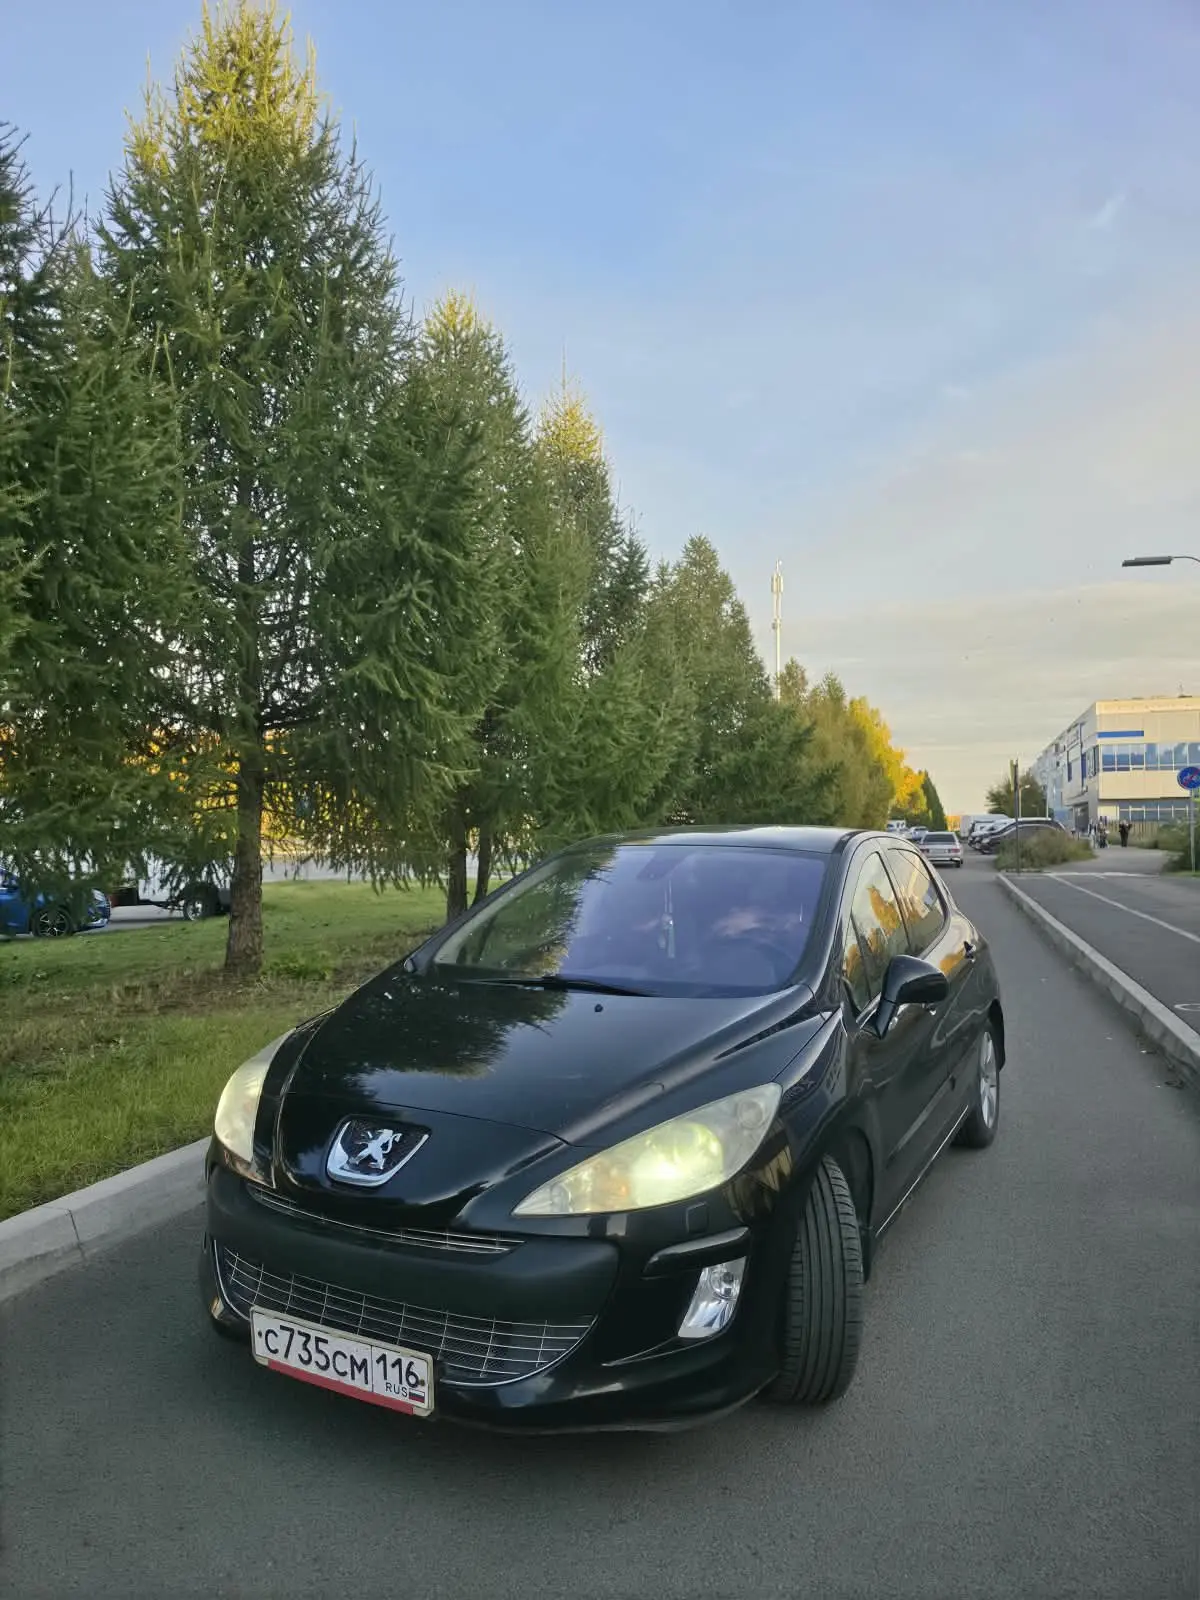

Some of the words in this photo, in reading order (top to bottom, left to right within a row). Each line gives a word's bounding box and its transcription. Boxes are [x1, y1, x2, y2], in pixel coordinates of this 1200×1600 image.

[264, 1325, 369, 1385] С735СМ
[376, 1353, 420, 1388] 116
[385, 1382, 408, 1398] RUS
